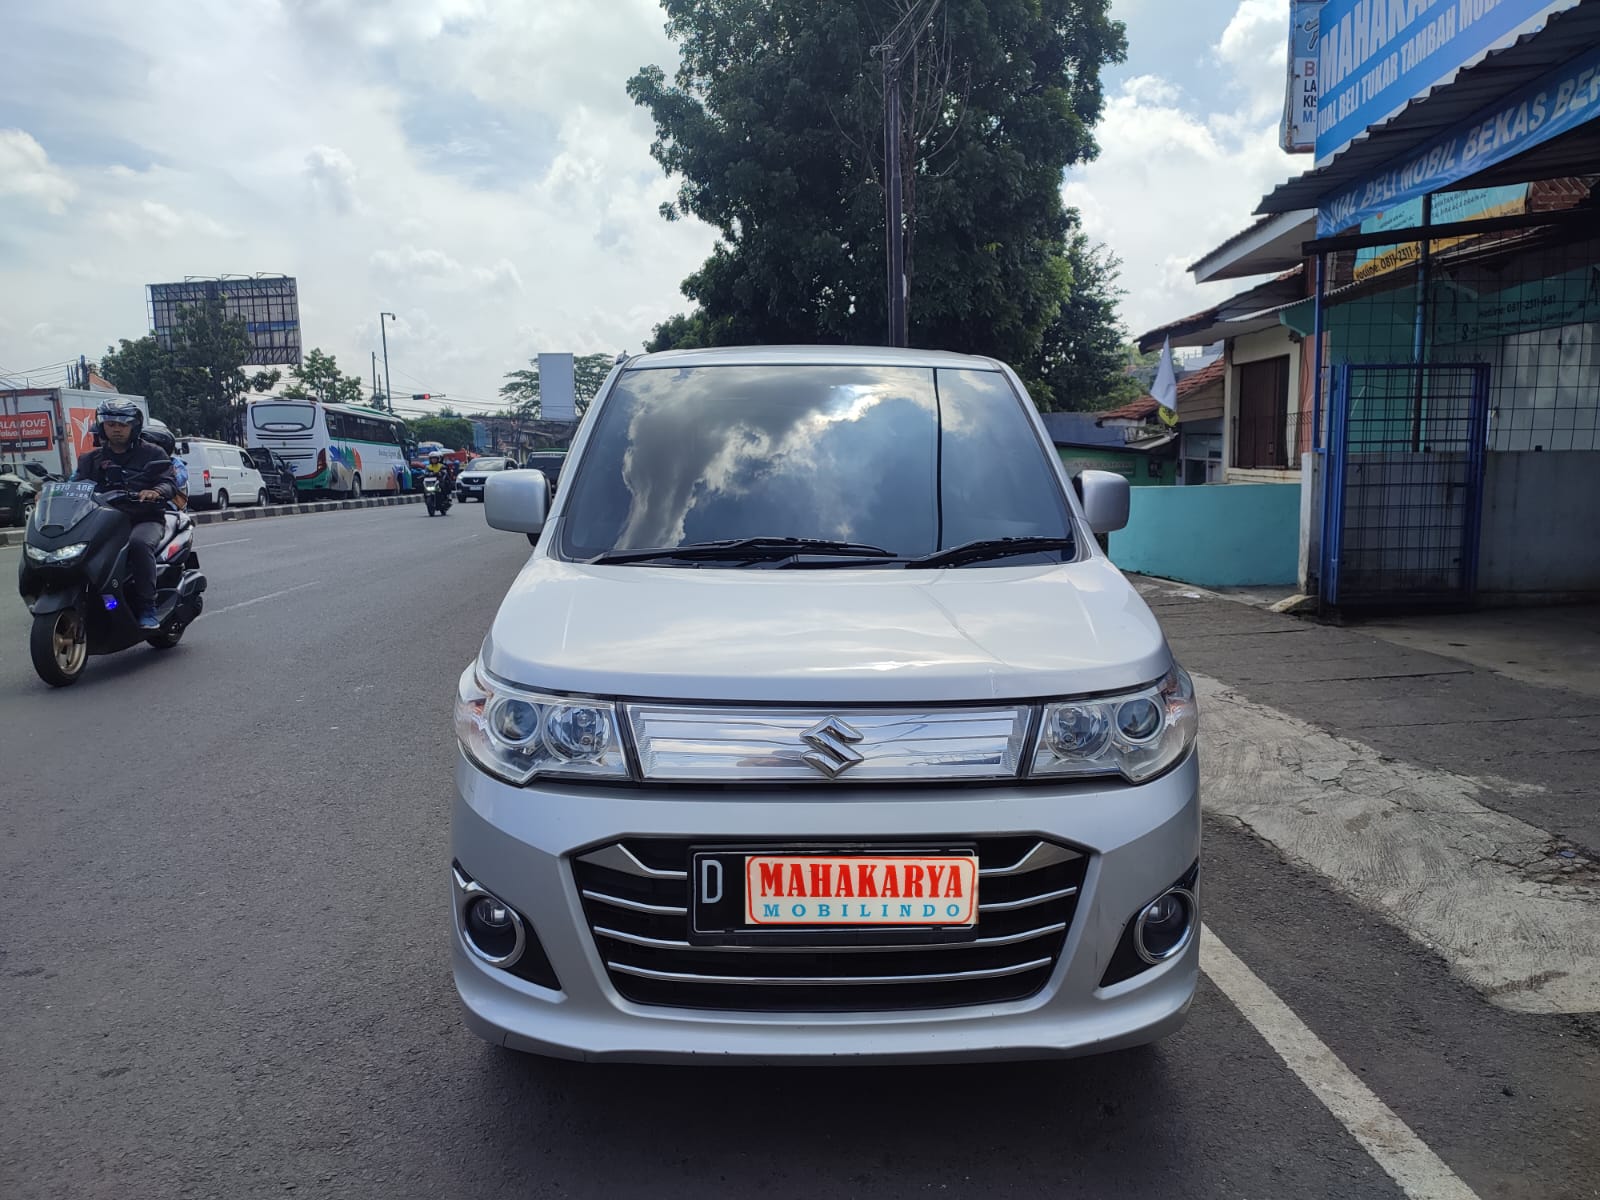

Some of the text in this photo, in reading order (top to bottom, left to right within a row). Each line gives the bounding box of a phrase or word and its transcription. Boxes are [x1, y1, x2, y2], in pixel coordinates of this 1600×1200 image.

[1304, 60, 1317, 77] B
[1317, 99, 1338, 137] JUAL
[1338, 81, 1360, 122] BELI
[1361, 52, 1399, 105] TUKAR
[1401, 4, 1457, 75] TAMBAH
[1330, 190, 1359, 226] JUAL
[1360, 172, 1397, 208] BELI
[1400, 137, 1458, 192] MOBIL
[1462, 92, 1548, 162] BEKAS
[702, 859, 724, 904] D
[758, 862, 963, 899] MAHAKARYA
[763, 903, 961, 918] MOBILINDO
